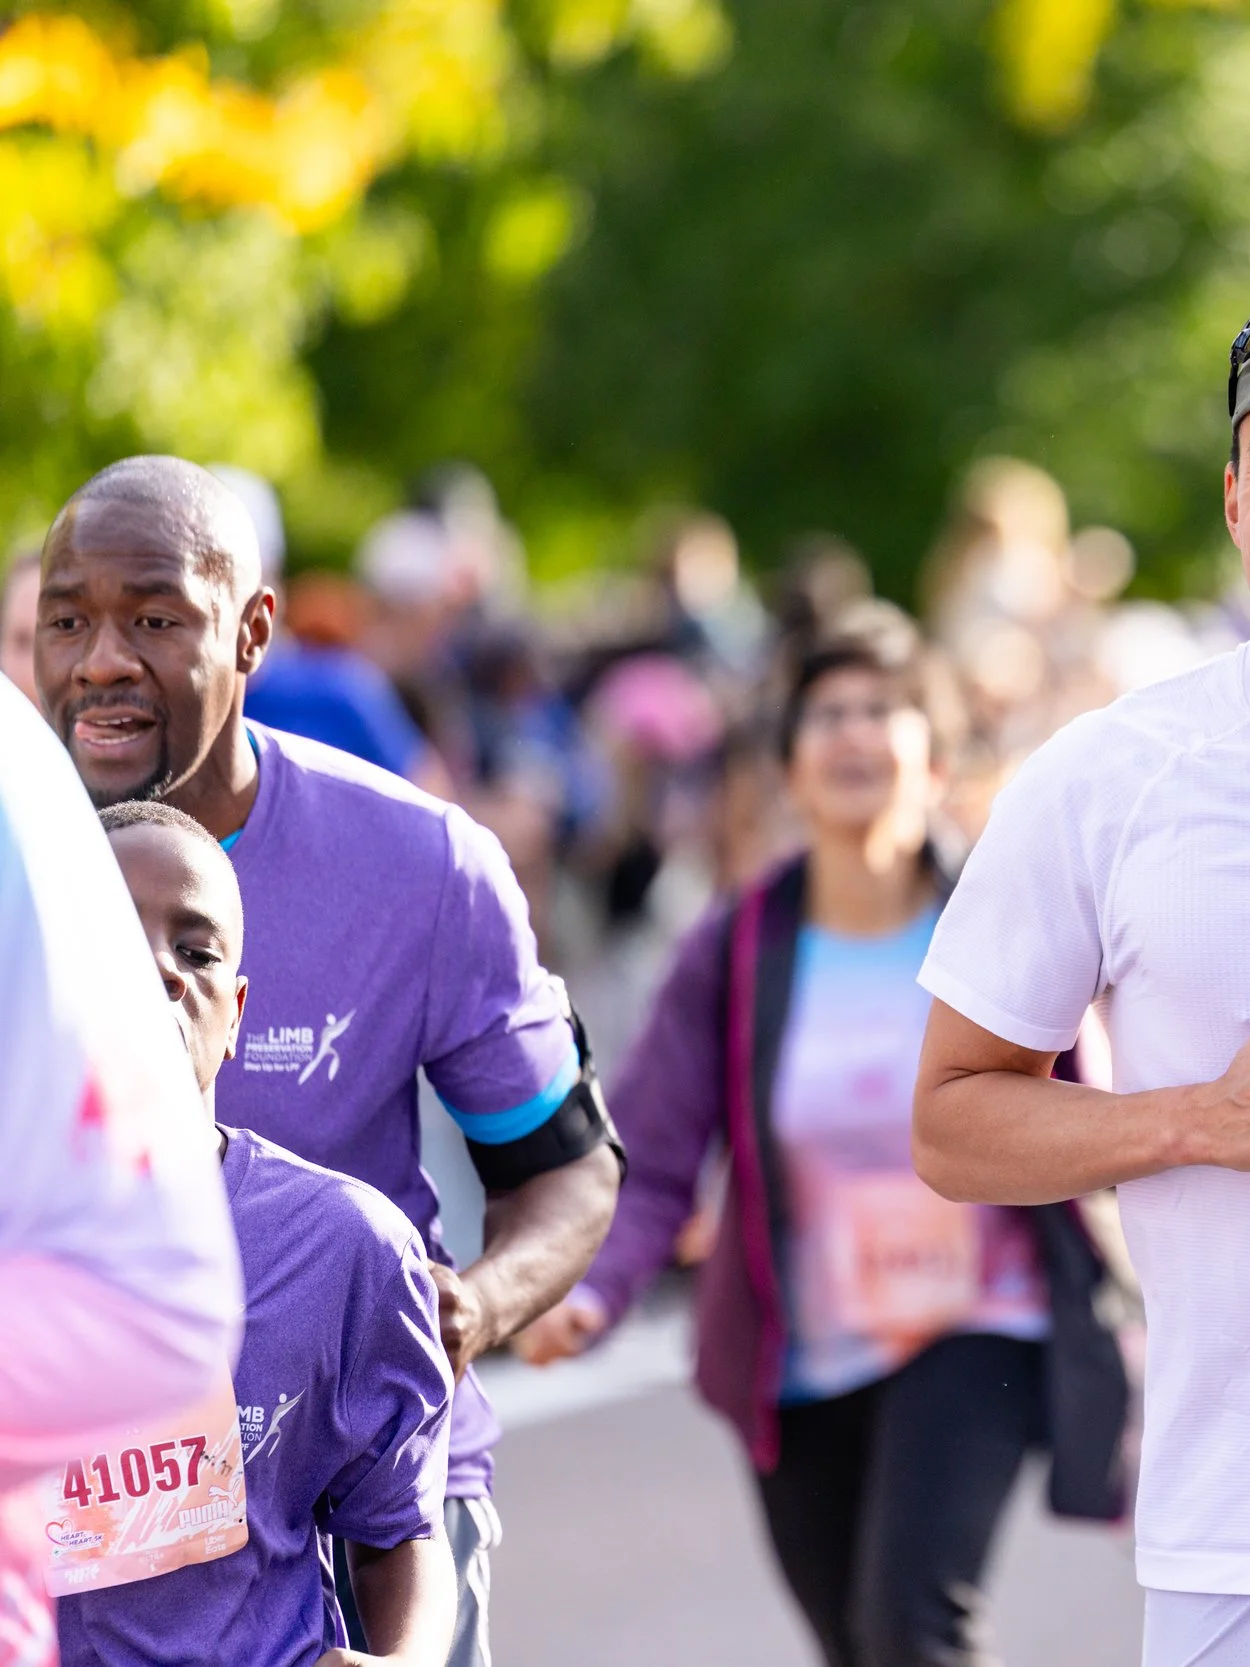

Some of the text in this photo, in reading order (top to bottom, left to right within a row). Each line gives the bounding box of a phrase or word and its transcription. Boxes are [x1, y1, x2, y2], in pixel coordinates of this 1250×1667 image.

[246, 1026, 314, 1044] THE LIMB
[236, 1405, 265, 1423] MB
[62, 1435, 207, 1508] 41057
[178, 1499, 229, 1530] PUMA
